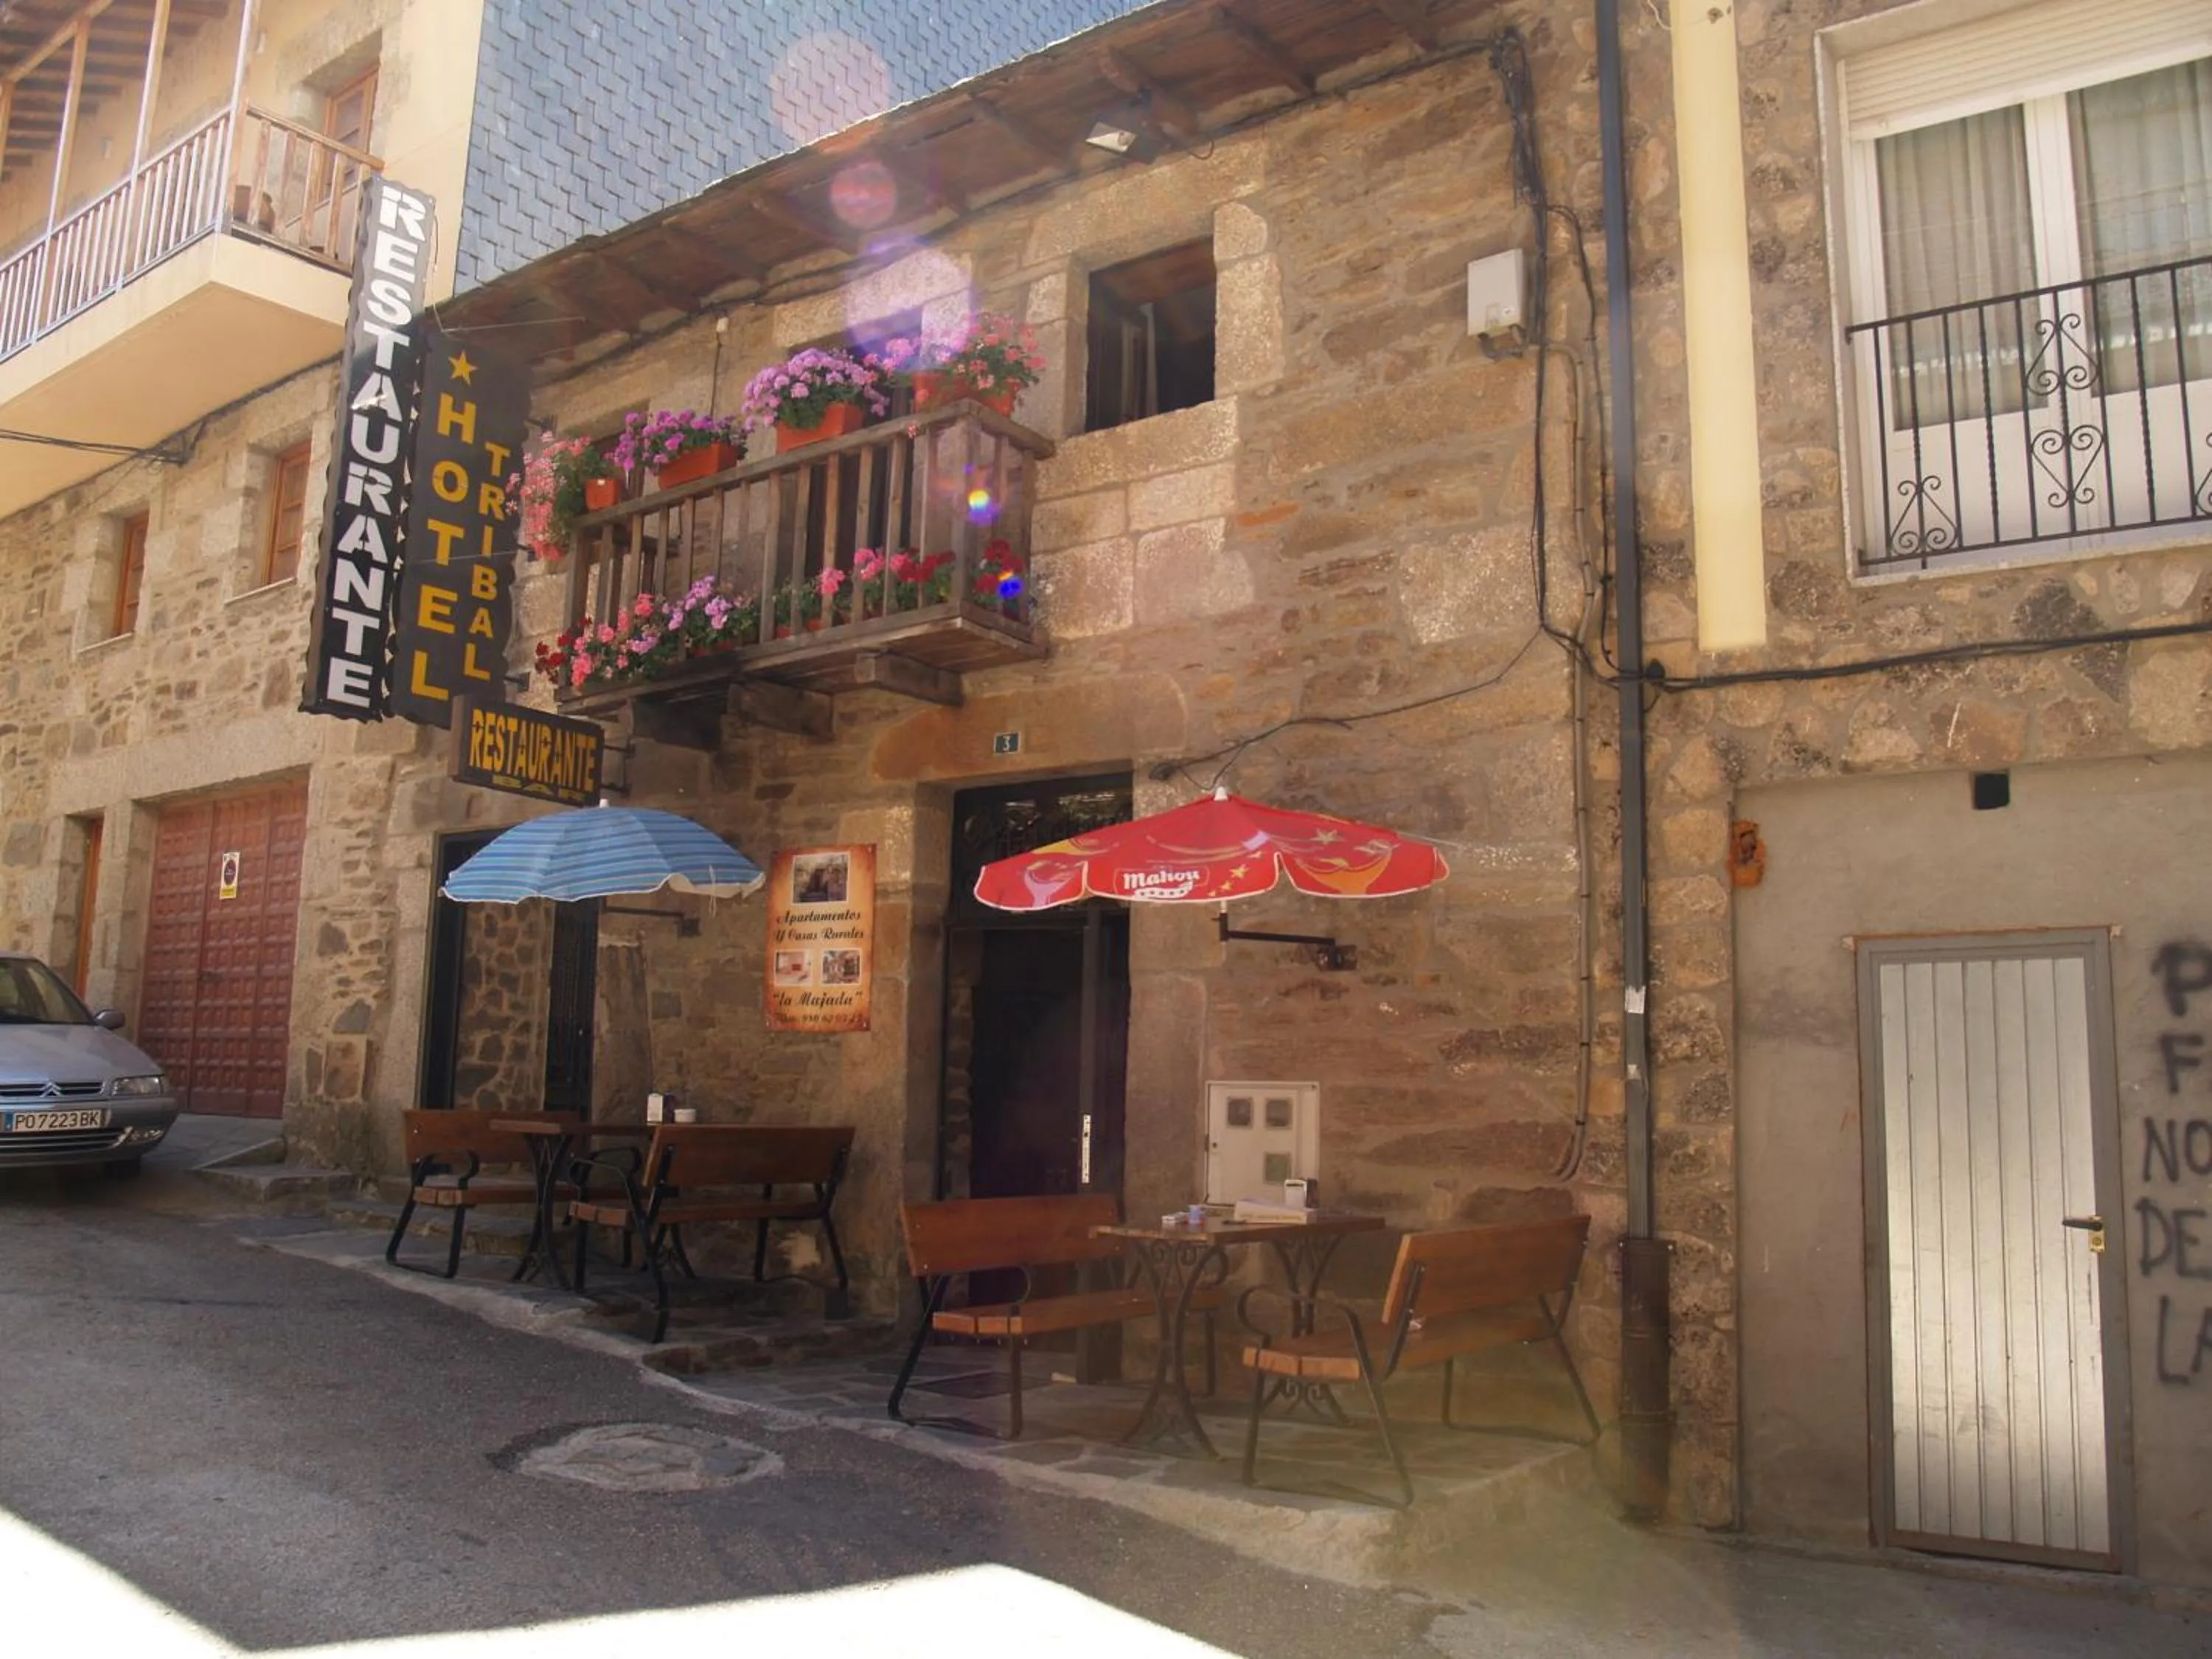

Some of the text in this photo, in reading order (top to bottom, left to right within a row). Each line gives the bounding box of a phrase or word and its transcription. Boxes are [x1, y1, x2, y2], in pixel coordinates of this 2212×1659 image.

[327, 185, 426, 708] RESTAURANTE
[411, 392, 476, 700] HOTEL
[464, 441, 510, 681] TRIBAL
[469, 708, 597, 792] RESTAURANTE
[1123, 870, 1200, 889] Mahou
[2160, 1033, 2212, 1093] F
[2143, 1116, 2212, 1182] NO
[2134, 1197, 2212, 1277] DE
